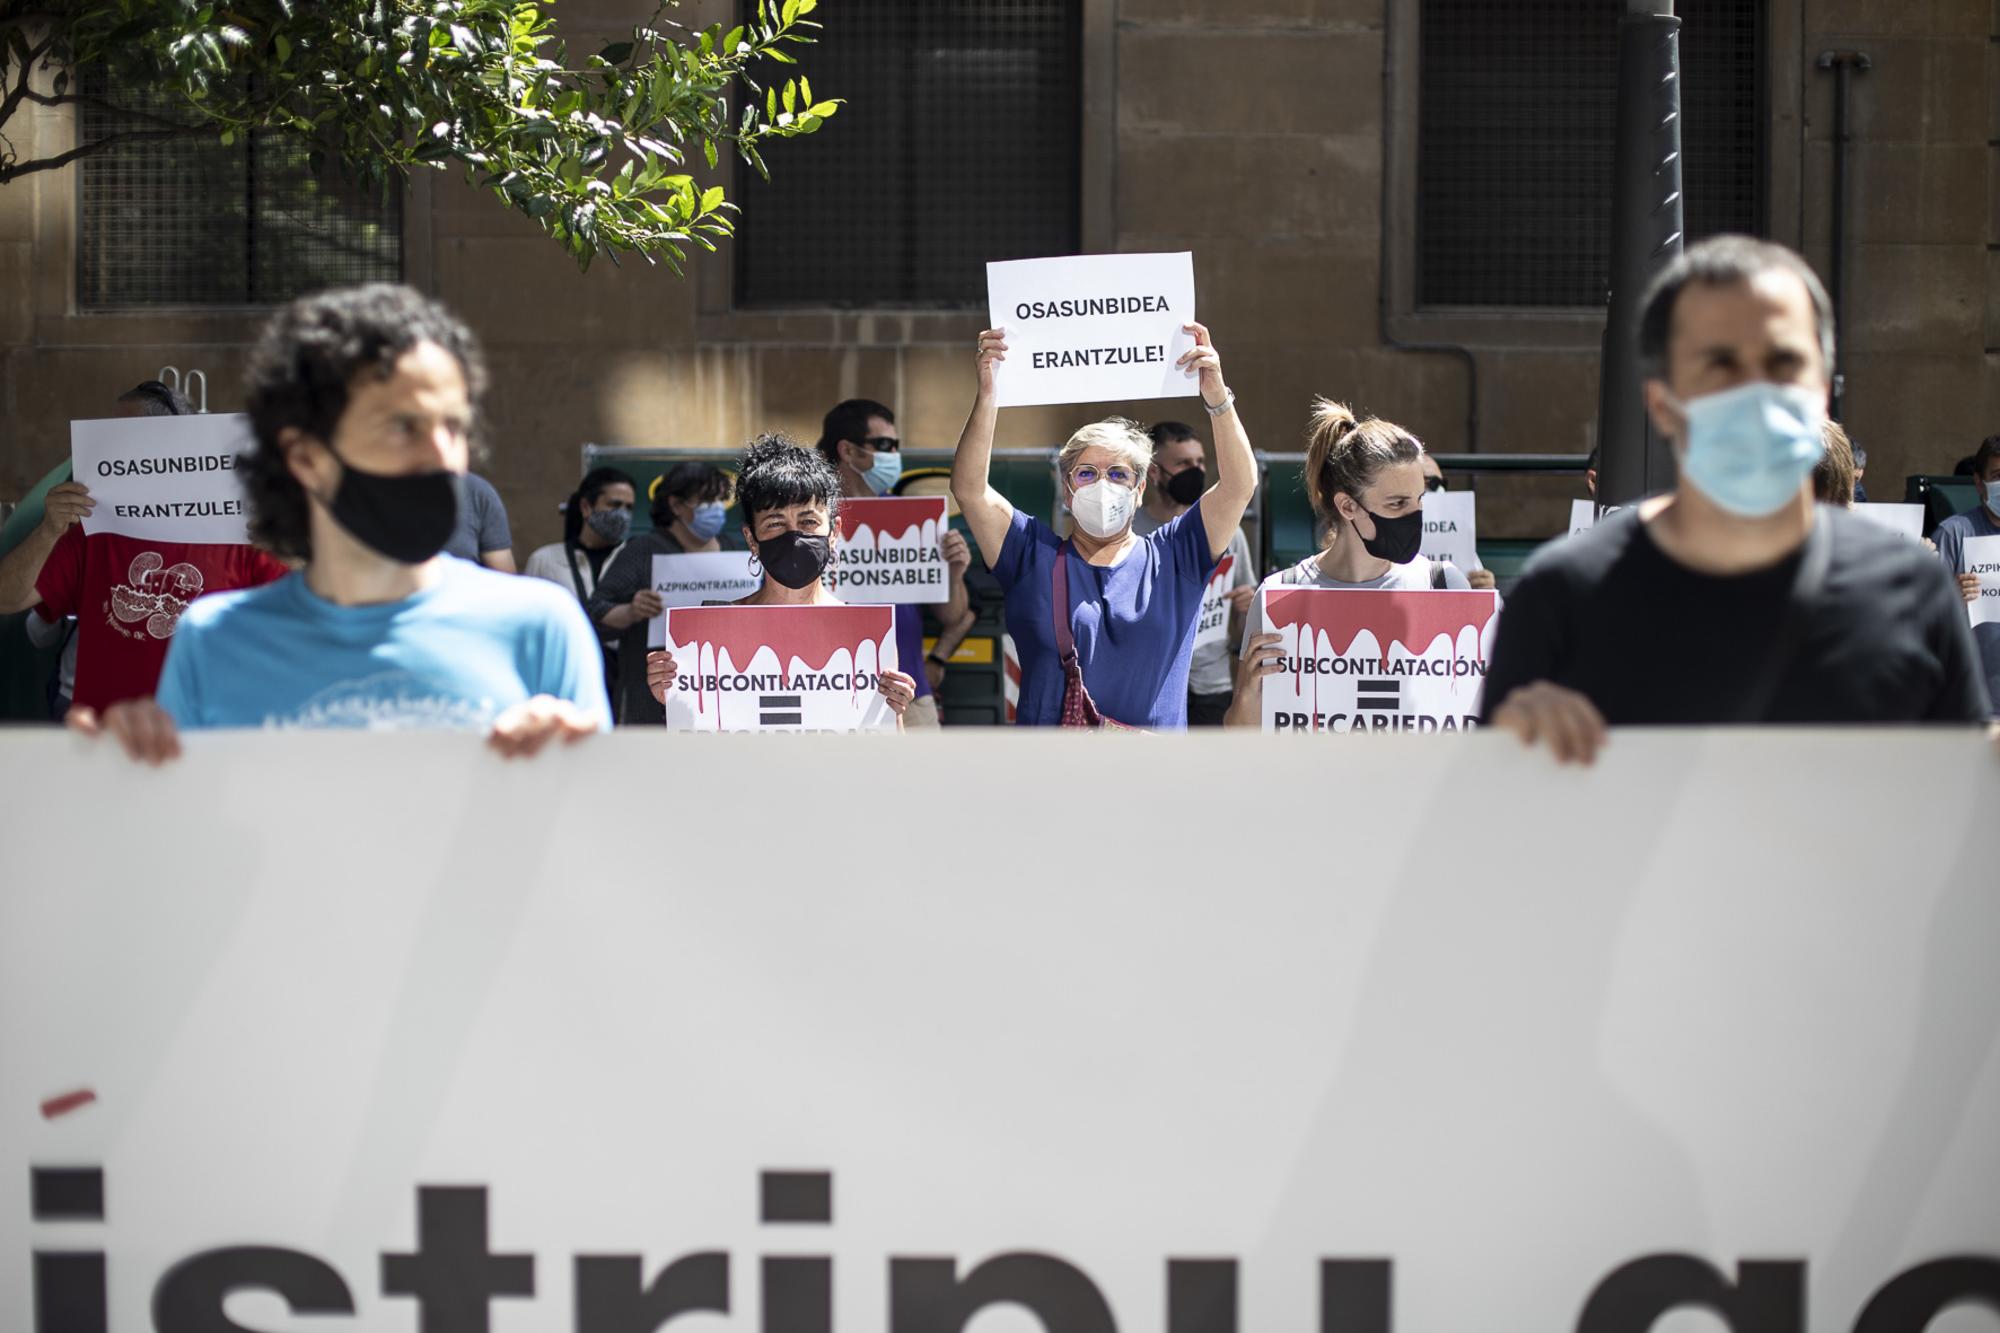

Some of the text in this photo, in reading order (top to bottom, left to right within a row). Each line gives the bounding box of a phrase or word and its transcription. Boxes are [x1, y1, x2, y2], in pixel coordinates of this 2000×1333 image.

[1015, 295, 1170, 320] OSASUNBIDEA
[1032, 345, 1165, 369] ERANTZULE!
[114, 500, 242, 518] ERANTZULE!
[1424, 520, 1457, 533] IDEA
[828, 547, 941, 565] SASUNBIDEA
[820, 568, 942, 586] ESPONSABLE!
[1276, 655, 1487, 677] SUBCONTRATACIÓN
